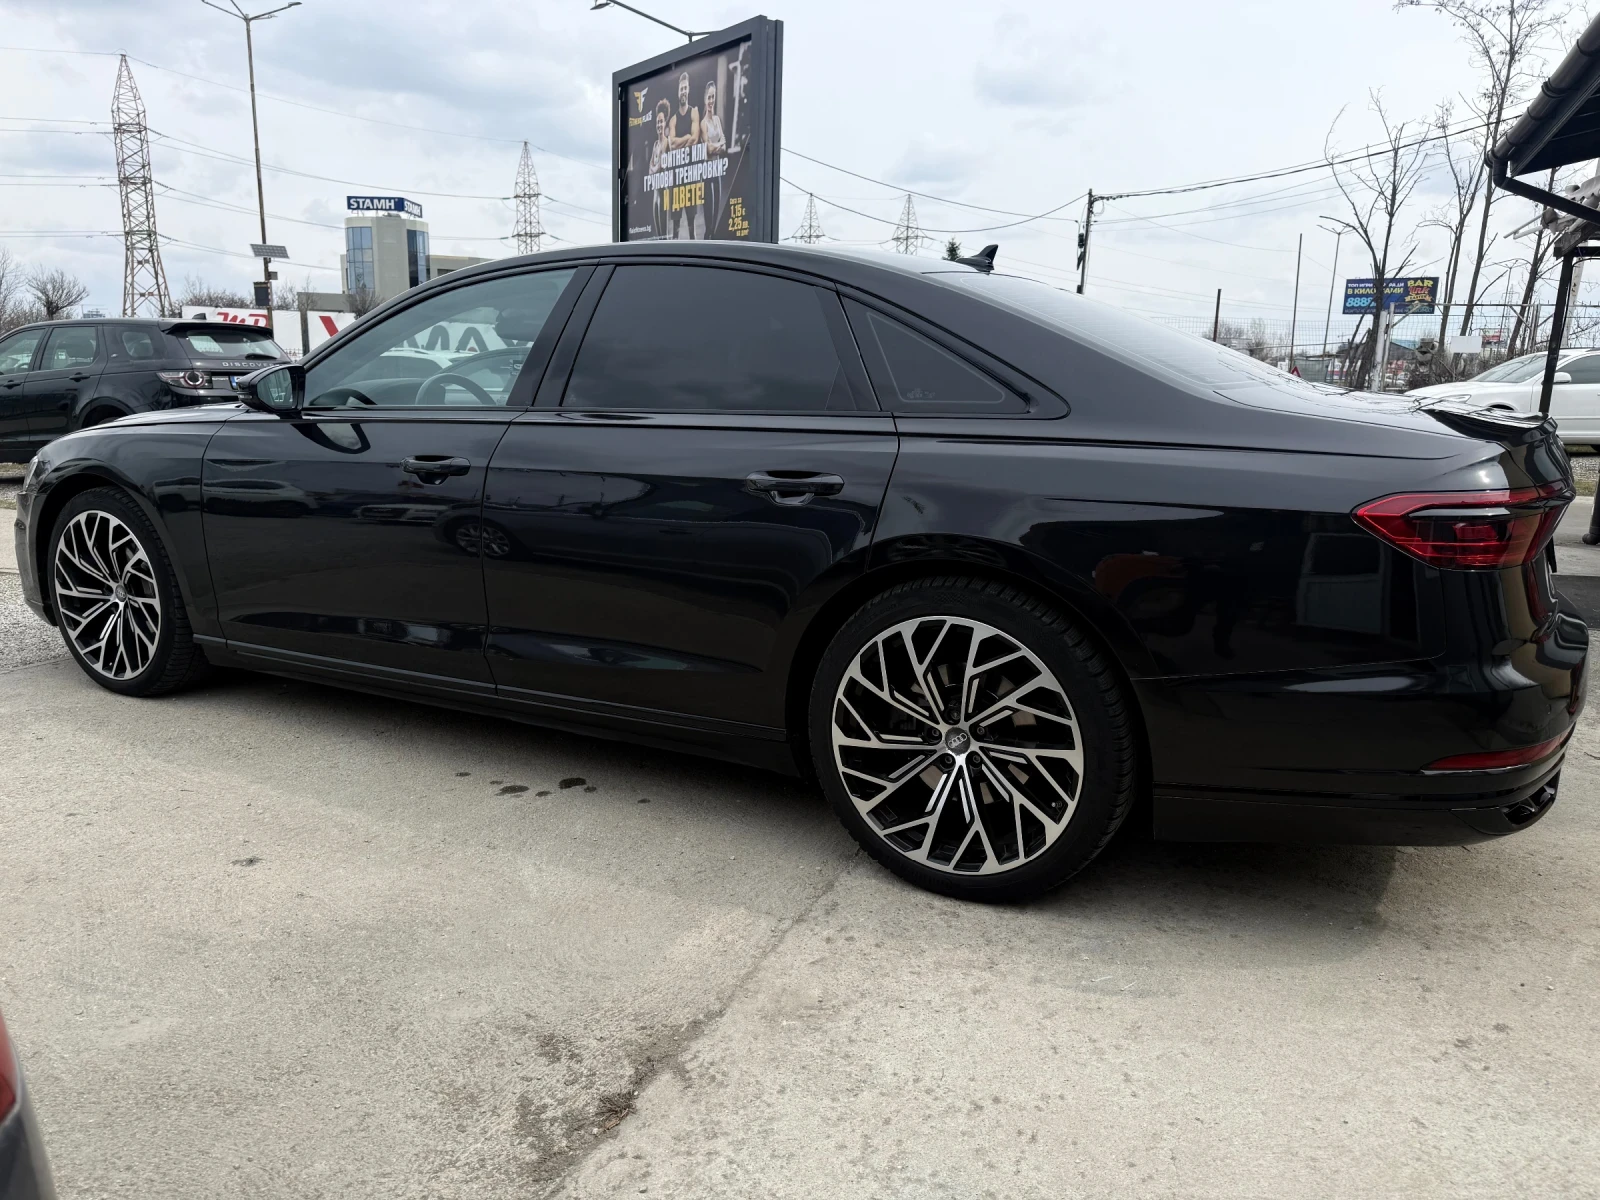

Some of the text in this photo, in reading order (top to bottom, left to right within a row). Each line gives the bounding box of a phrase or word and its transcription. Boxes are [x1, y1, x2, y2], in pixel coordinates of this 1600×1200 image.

[661, 142, 708, 169] ФИТНЕС ИЛИ
[643, 157, 729, 192] ГРУПОВИ ТРЕНИРОВКИ?
[663, 182, 705, 212] И ДВЕТЕ!
[1407, 279, 1434, 287] BAR
